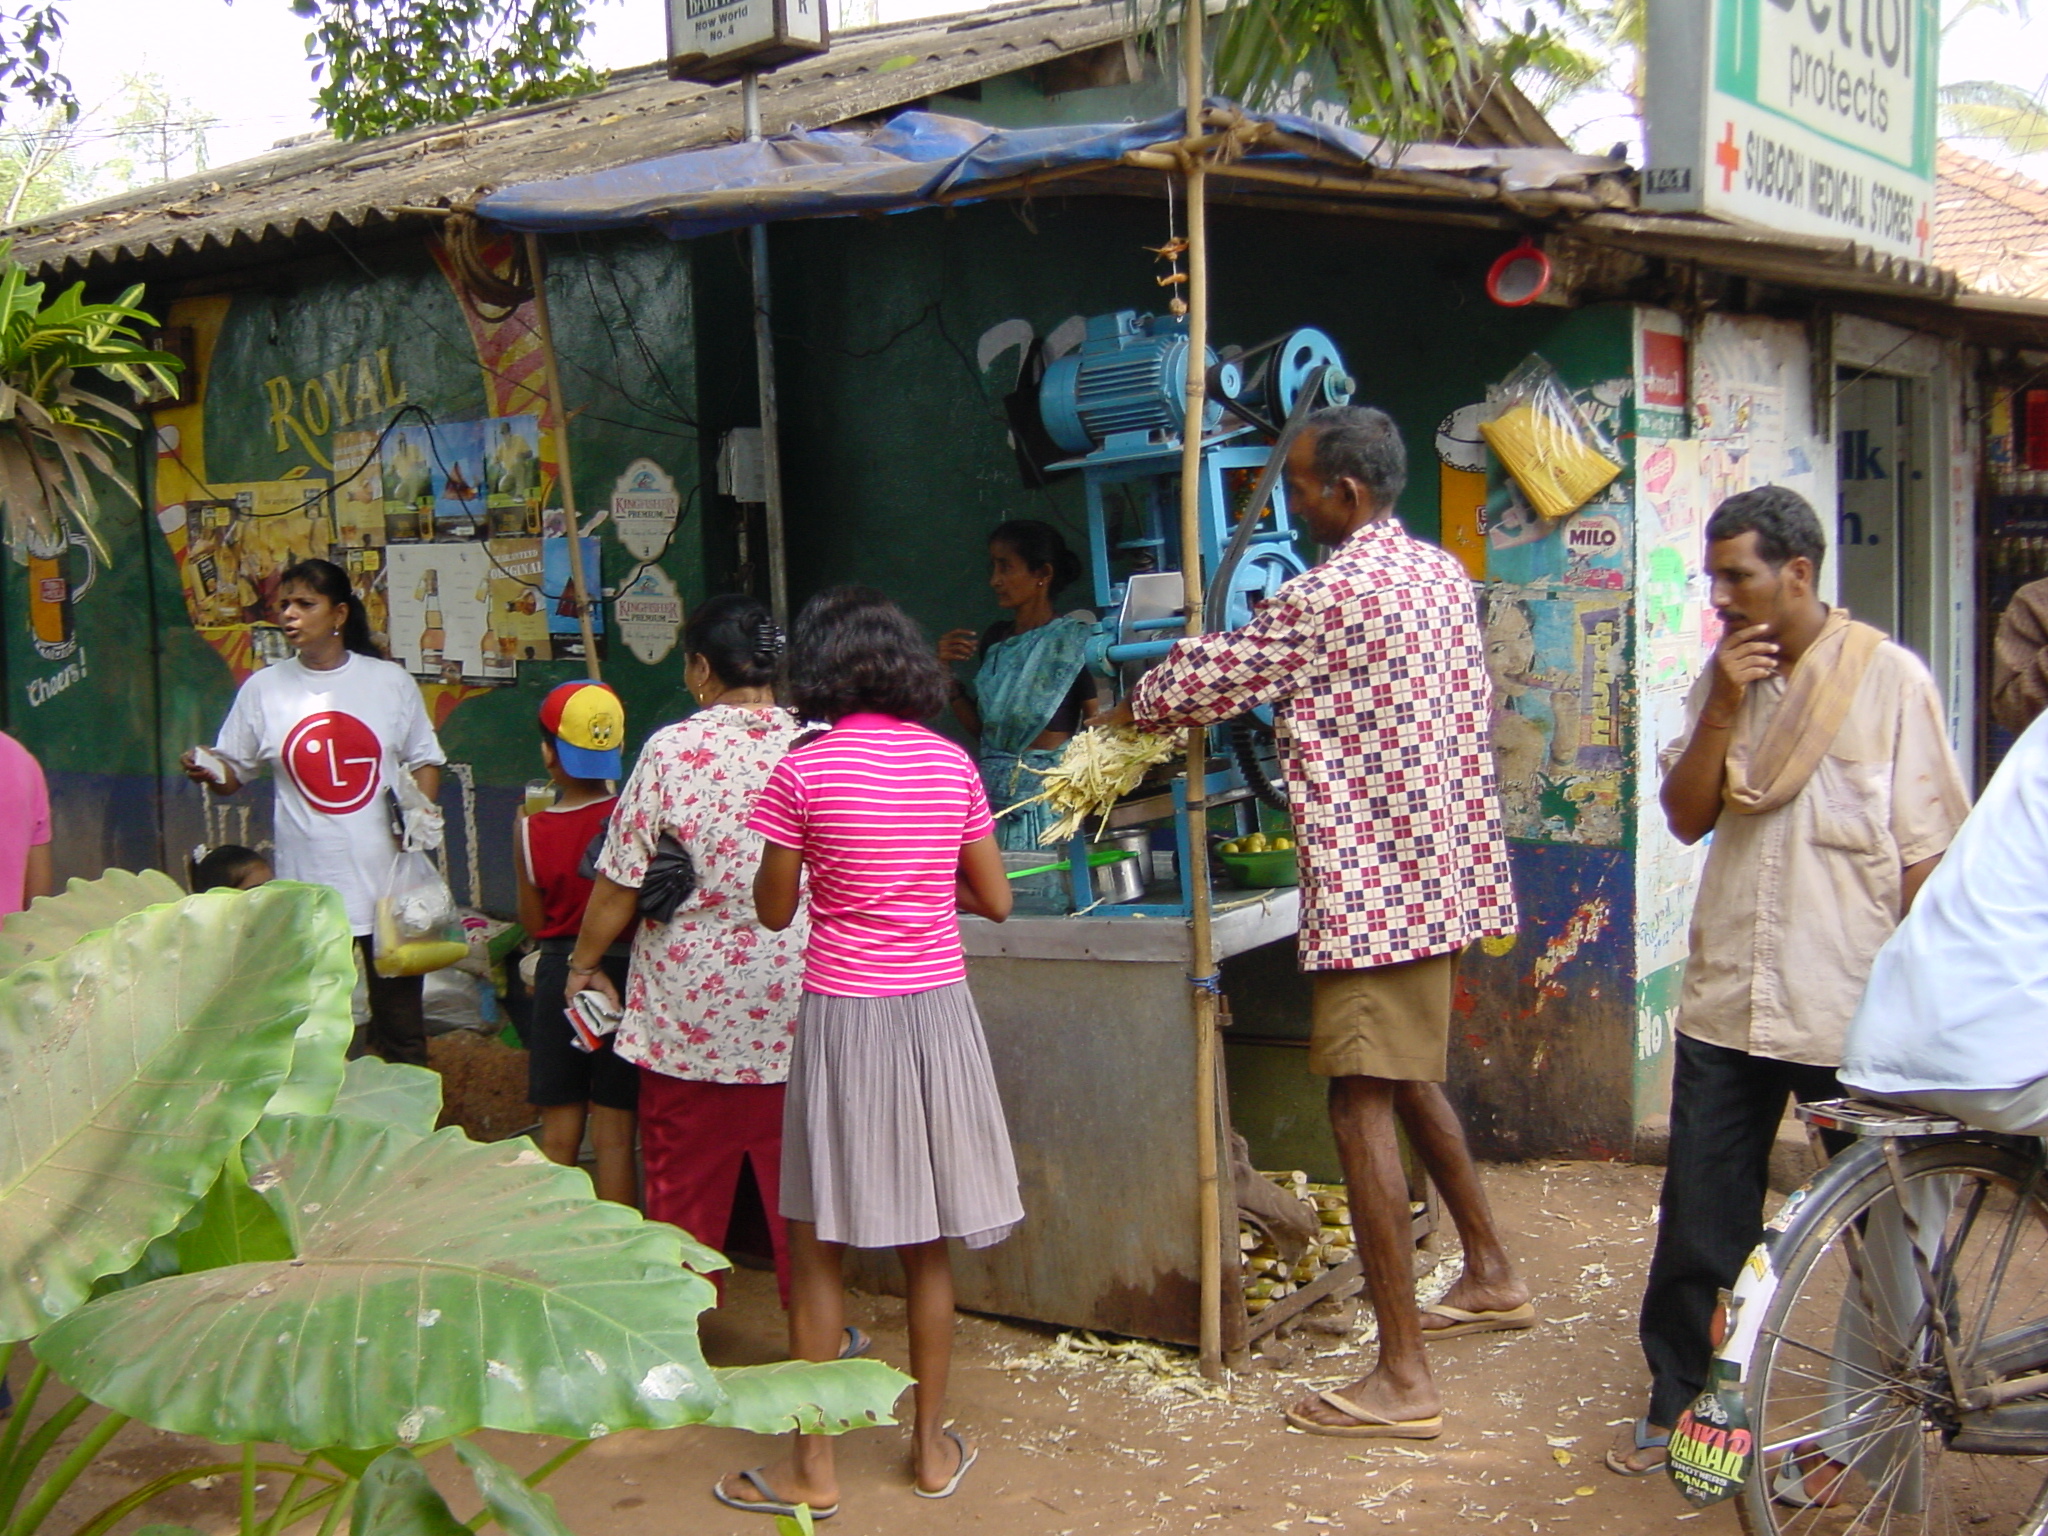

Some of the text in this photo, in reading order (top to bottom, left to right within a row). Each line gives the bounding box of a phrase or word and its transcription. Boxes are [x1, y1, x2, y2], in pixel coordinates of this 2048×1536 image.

[719, 5, 748, 25] World
[1765, 0, 1911, 79] ttol
[1789, 43, 1889, 134] protects
[1745, 130, 1914, 246] SUBODH MEDICAL STORES
[264, 346, 409, 471] ROYAL
[615, 497, 677, 515] KINGFISHER
[627, 510, 664, 519] PREMIUM
[1569, 529, 1617, 547] MILO
[618, 600, 679, 619] KINGFISHER
[630, 613, 667, 622] PREMIUM
[1671, 1459, 1729, 1487] BROTHERS
[1674, 1470, 1723, 1496] PANAJI
